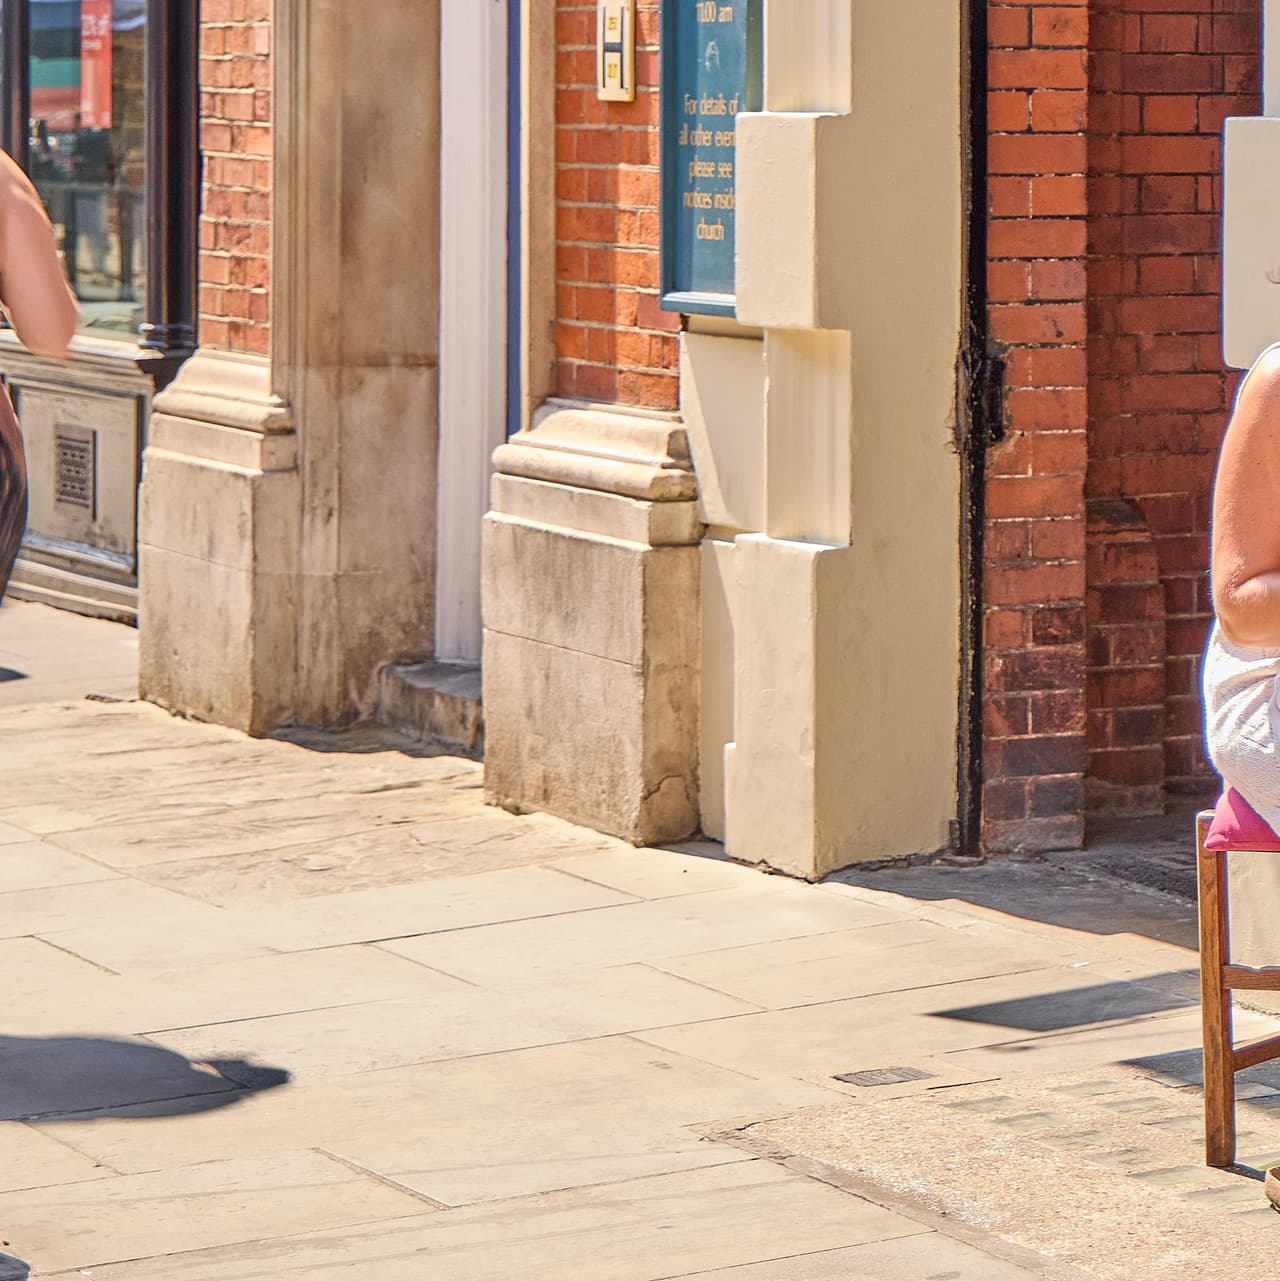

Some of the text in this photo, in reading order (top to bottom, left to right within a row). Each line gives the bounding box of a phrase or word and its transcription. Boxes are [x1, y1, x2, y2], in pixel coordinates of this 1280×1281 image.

[718, 6, 734, 23] am
[684, 93, 740, 116] For details of
[679, 123, 689, 145] all
[690, 123, 713, 147] other
[688, 154, 733, 184] please see
[683, 186, 736, 210] notices insid
[695, 217, 725, 241] church
